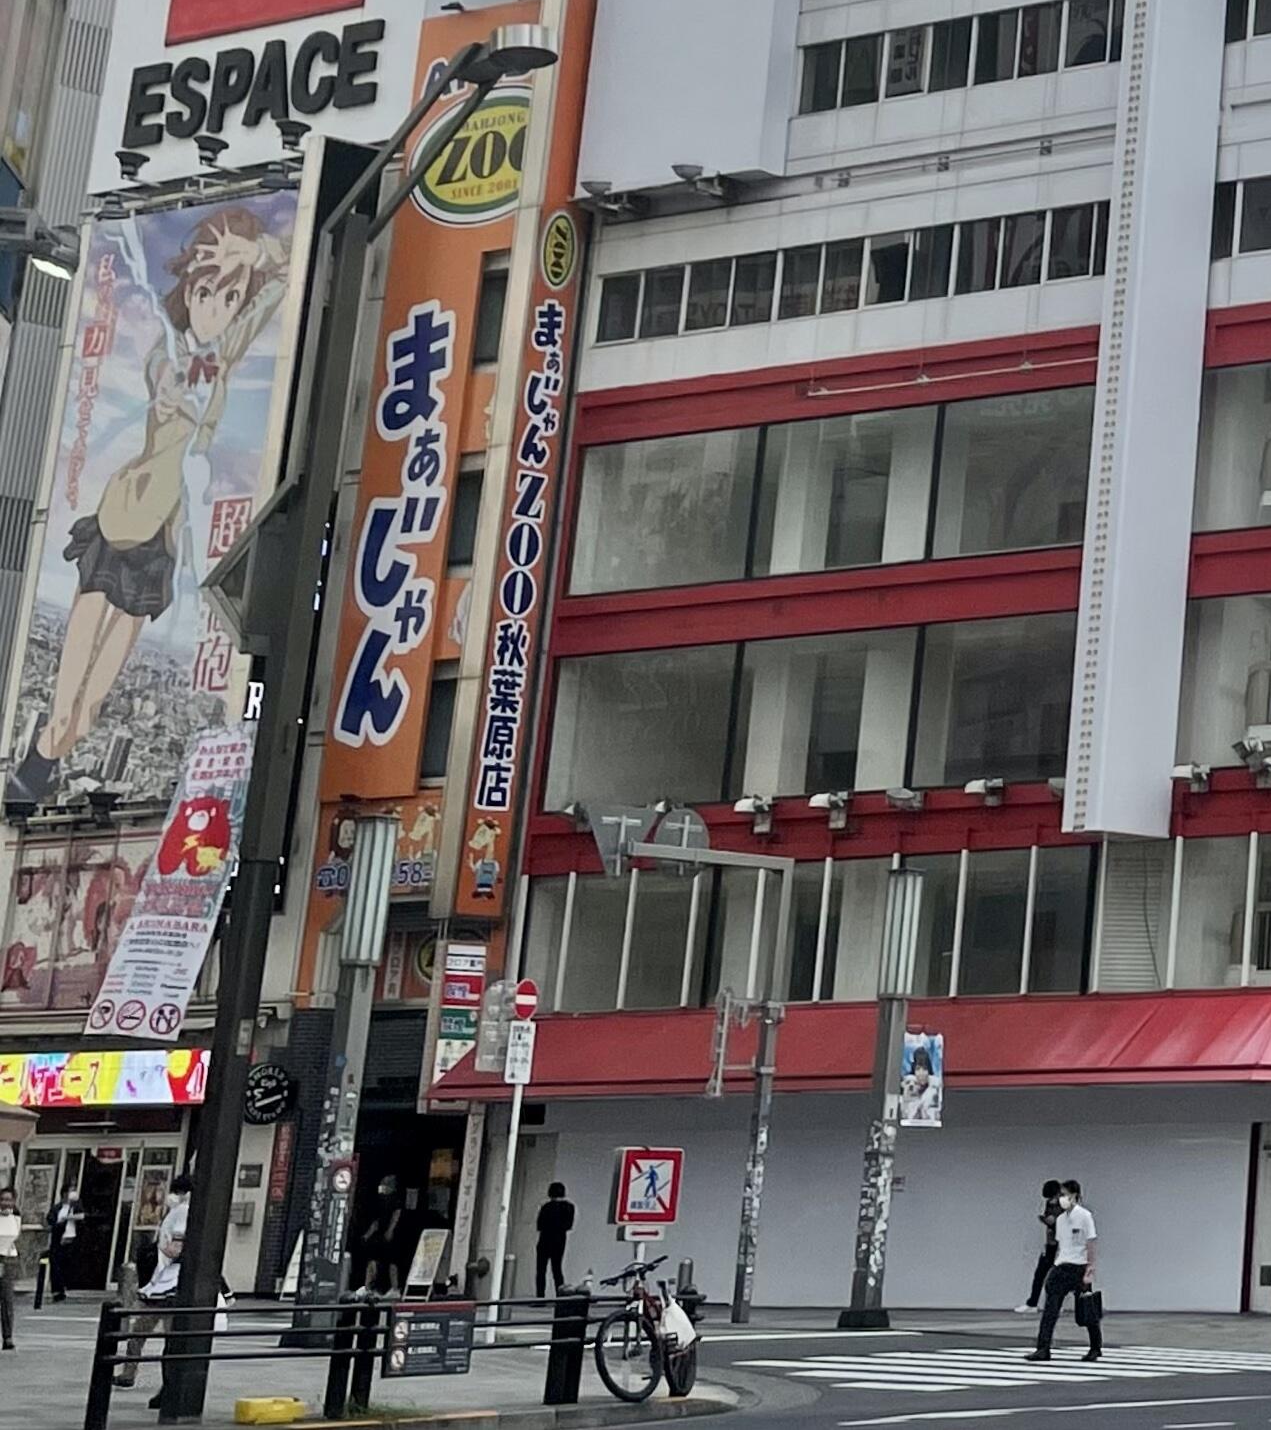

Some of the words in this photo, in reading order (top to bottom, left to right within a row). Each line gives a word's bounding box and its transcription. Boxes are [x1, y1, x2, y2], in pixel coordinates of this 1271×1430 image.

[121, 18, 386, 149] ESPACE
[450, 185, 484, 200] SINCE
[551, 224, 569, 279] ZOO
[336, 303, 454, 745] まぁじゃん
